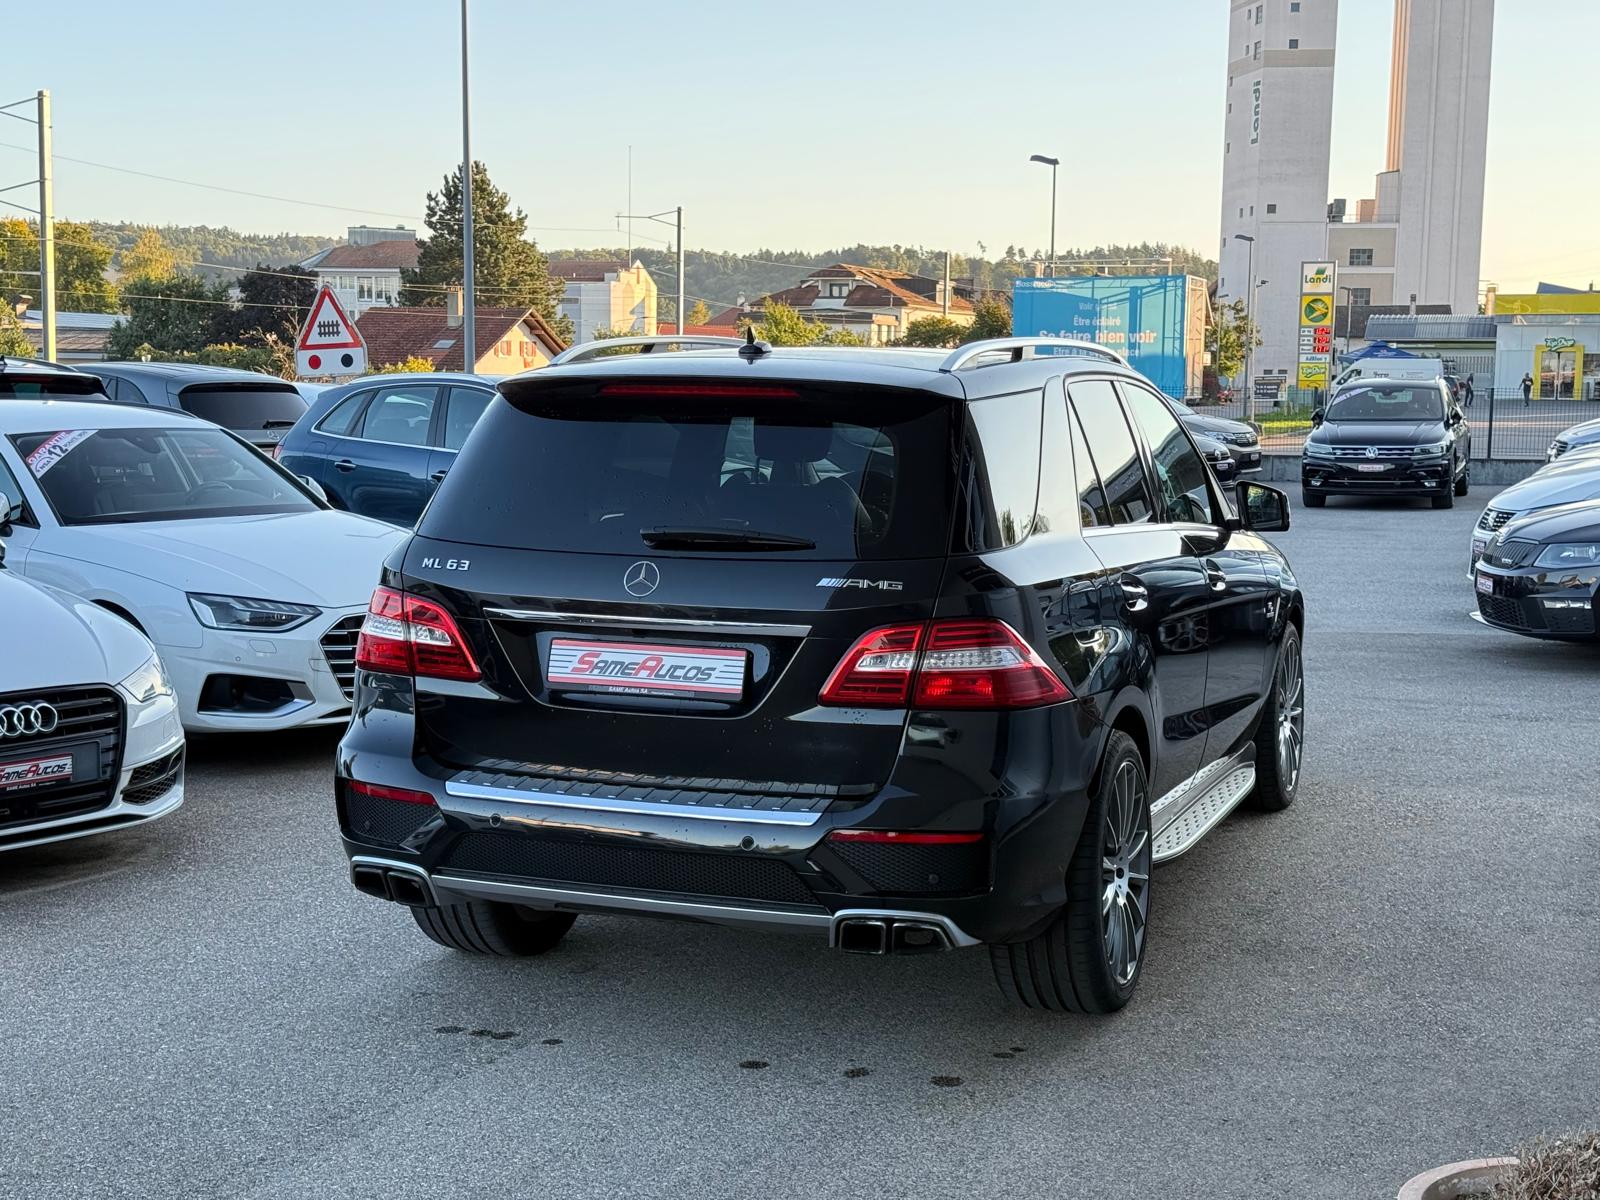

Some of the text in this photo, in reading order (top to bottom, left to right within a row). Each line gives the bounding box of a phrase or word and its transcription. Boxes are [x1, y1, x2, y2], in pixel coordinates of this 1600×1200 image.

[1250, 79, 1261, 145] Landi
[1304, 274, 1332, 284] Landi
[1059, 330, 1092, 342] faire
[1096, 331, 1125, 343] bien
[1129, 330, 1157, 343] voir
[28, 431, 66, 464] GARANTIE
[47, 444, 69, 458] 12
[422, 558, 471, 571] ML 63
[843, 579, 903, 590] AMG
